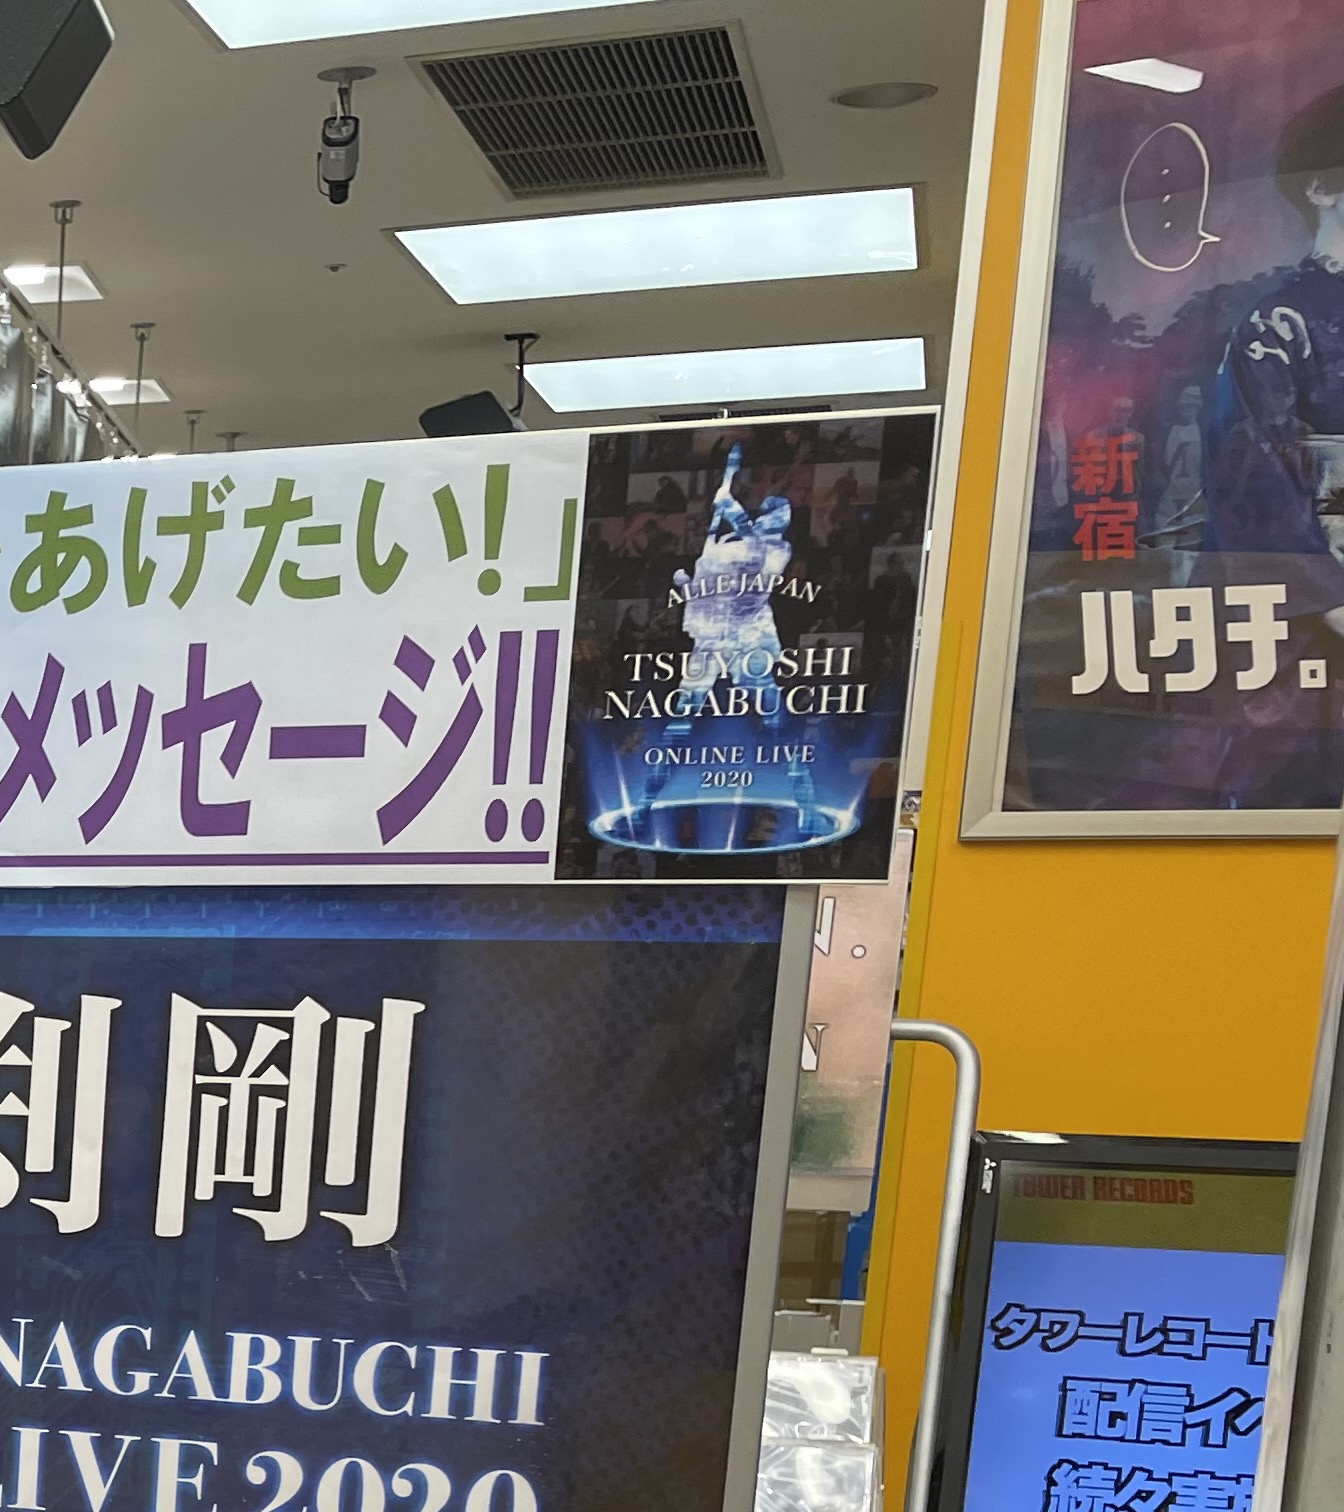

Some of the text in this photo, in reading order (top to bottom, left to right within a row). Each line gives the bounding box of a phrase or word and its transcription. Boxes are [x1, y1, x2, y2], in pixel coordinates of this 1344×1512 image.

[1070, 432, 1141, 562] 新宿
[667, 574, 822, 608] ALLE JAPAN
[1071, 583, 1329, 695] ハタチ。
[624, 647, 854, 682] TSUYOSHI
[603, 684, 869, 720] NAGABUCHI
[644, 745, 816, 765] ONLINE LIVE
[700, 771, 753, 788] 2020
[1093, 1176, 1195, 1205] RECORDS
